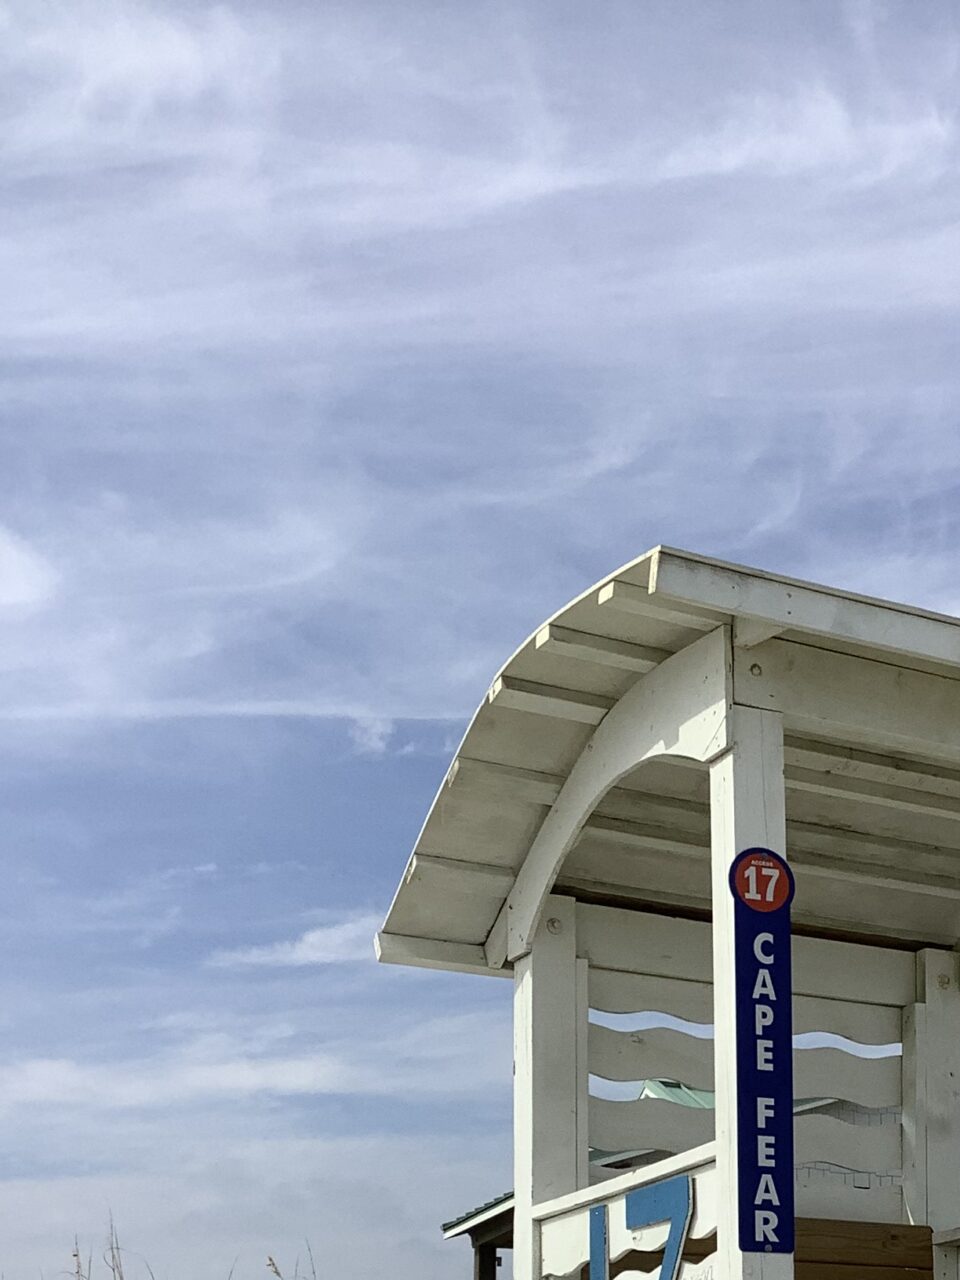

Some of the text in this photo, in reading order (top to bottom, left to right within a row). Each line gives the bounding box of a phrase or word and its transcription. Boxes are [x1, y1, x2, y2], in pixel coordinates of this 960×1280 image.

[744, 866, 780, 902] 17
[752, 932, 780, 1242] CAPE FEAR
